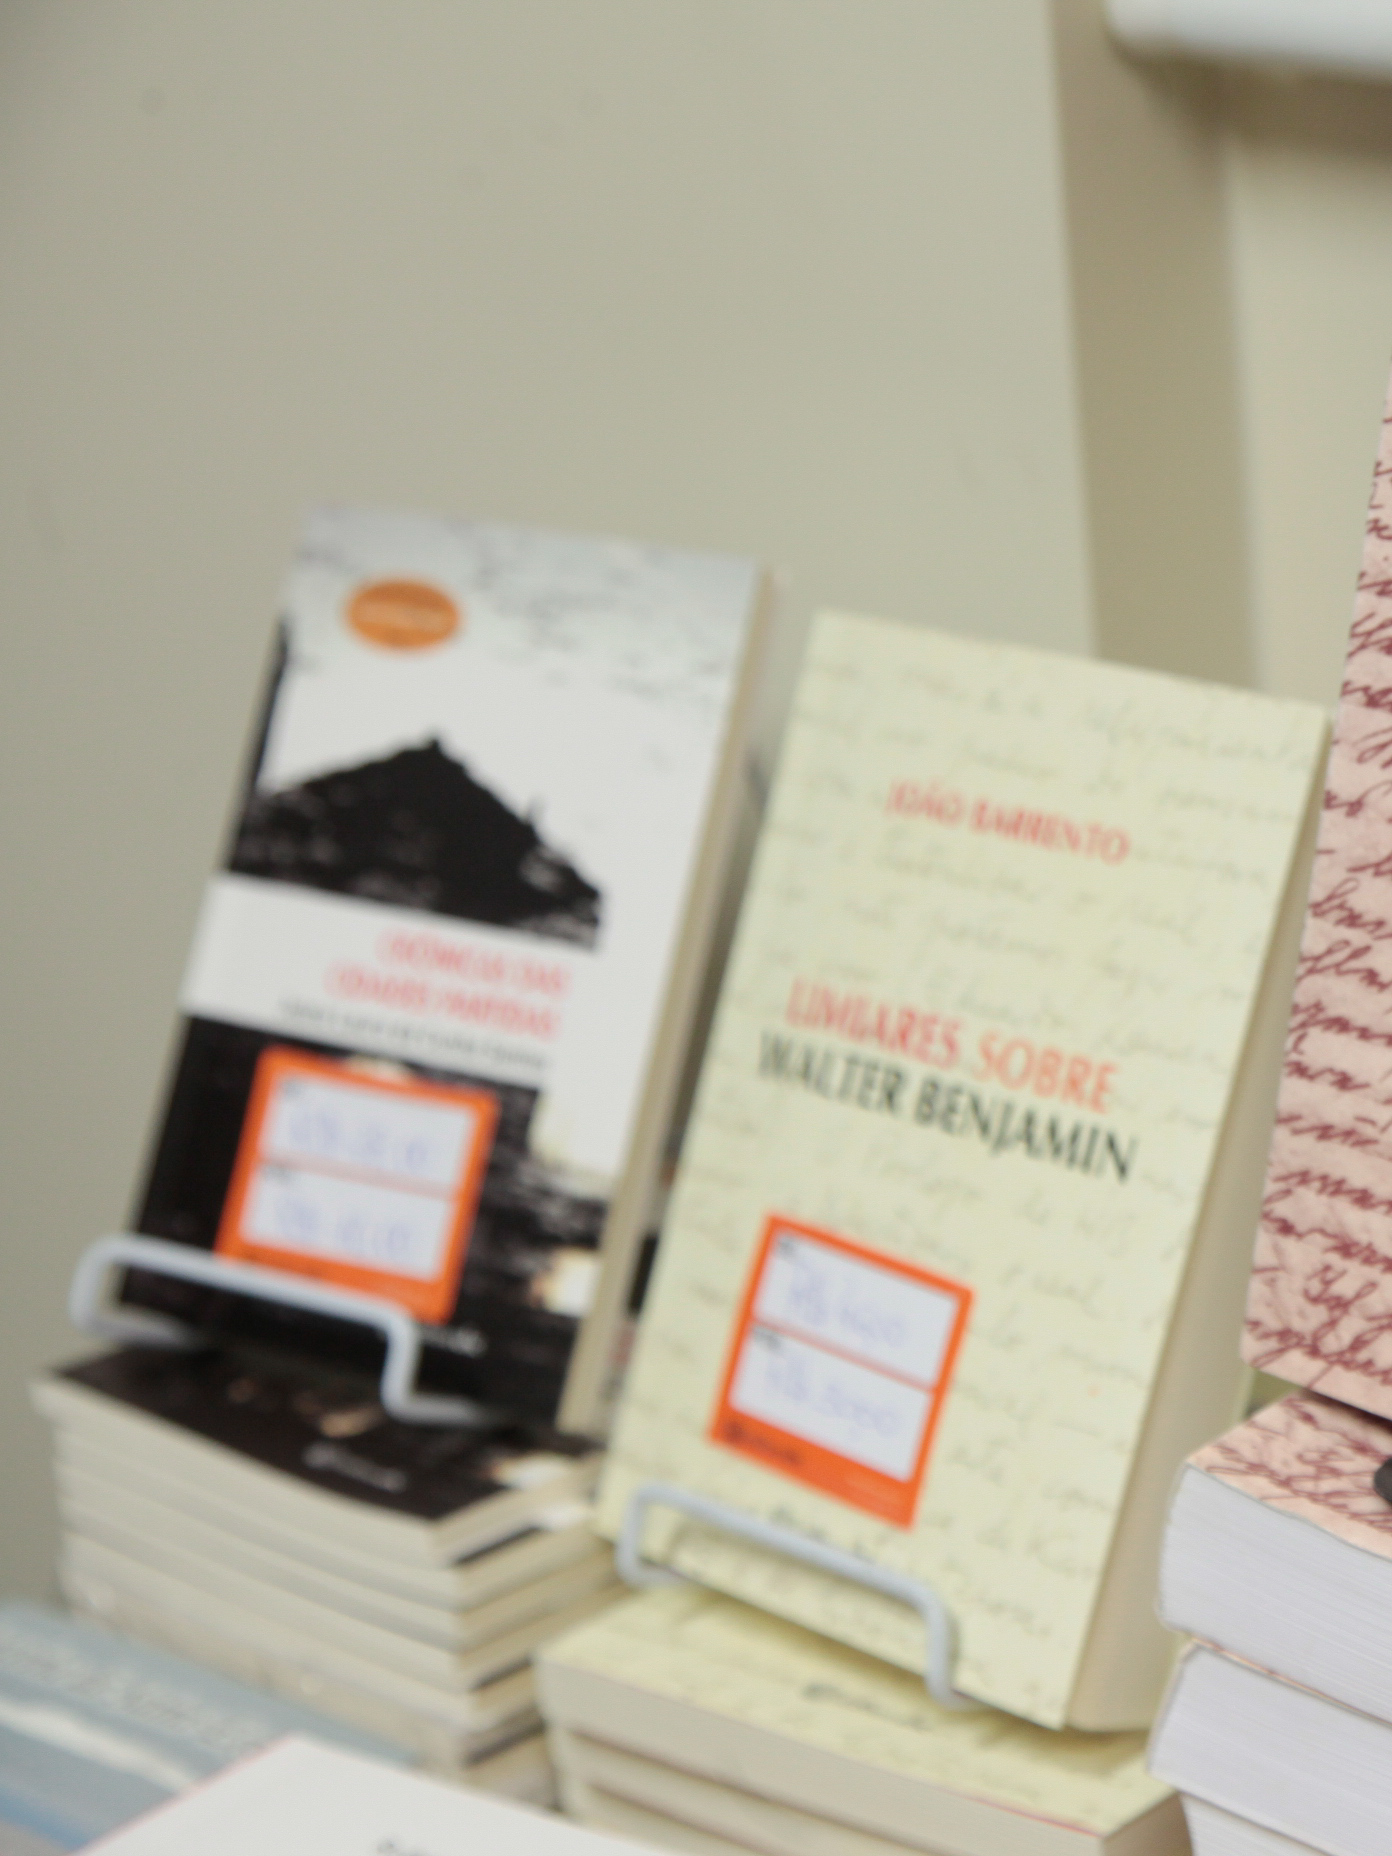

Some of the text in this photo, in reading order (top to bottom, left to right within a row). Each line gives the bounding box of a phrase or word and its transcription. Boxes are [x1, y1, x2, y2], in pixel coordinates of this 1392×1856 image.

[759, 1029, 1138, 1184] WALTER BENJAMIN
[785, 977, 1117, 1114] LIMIARES SOBRE
